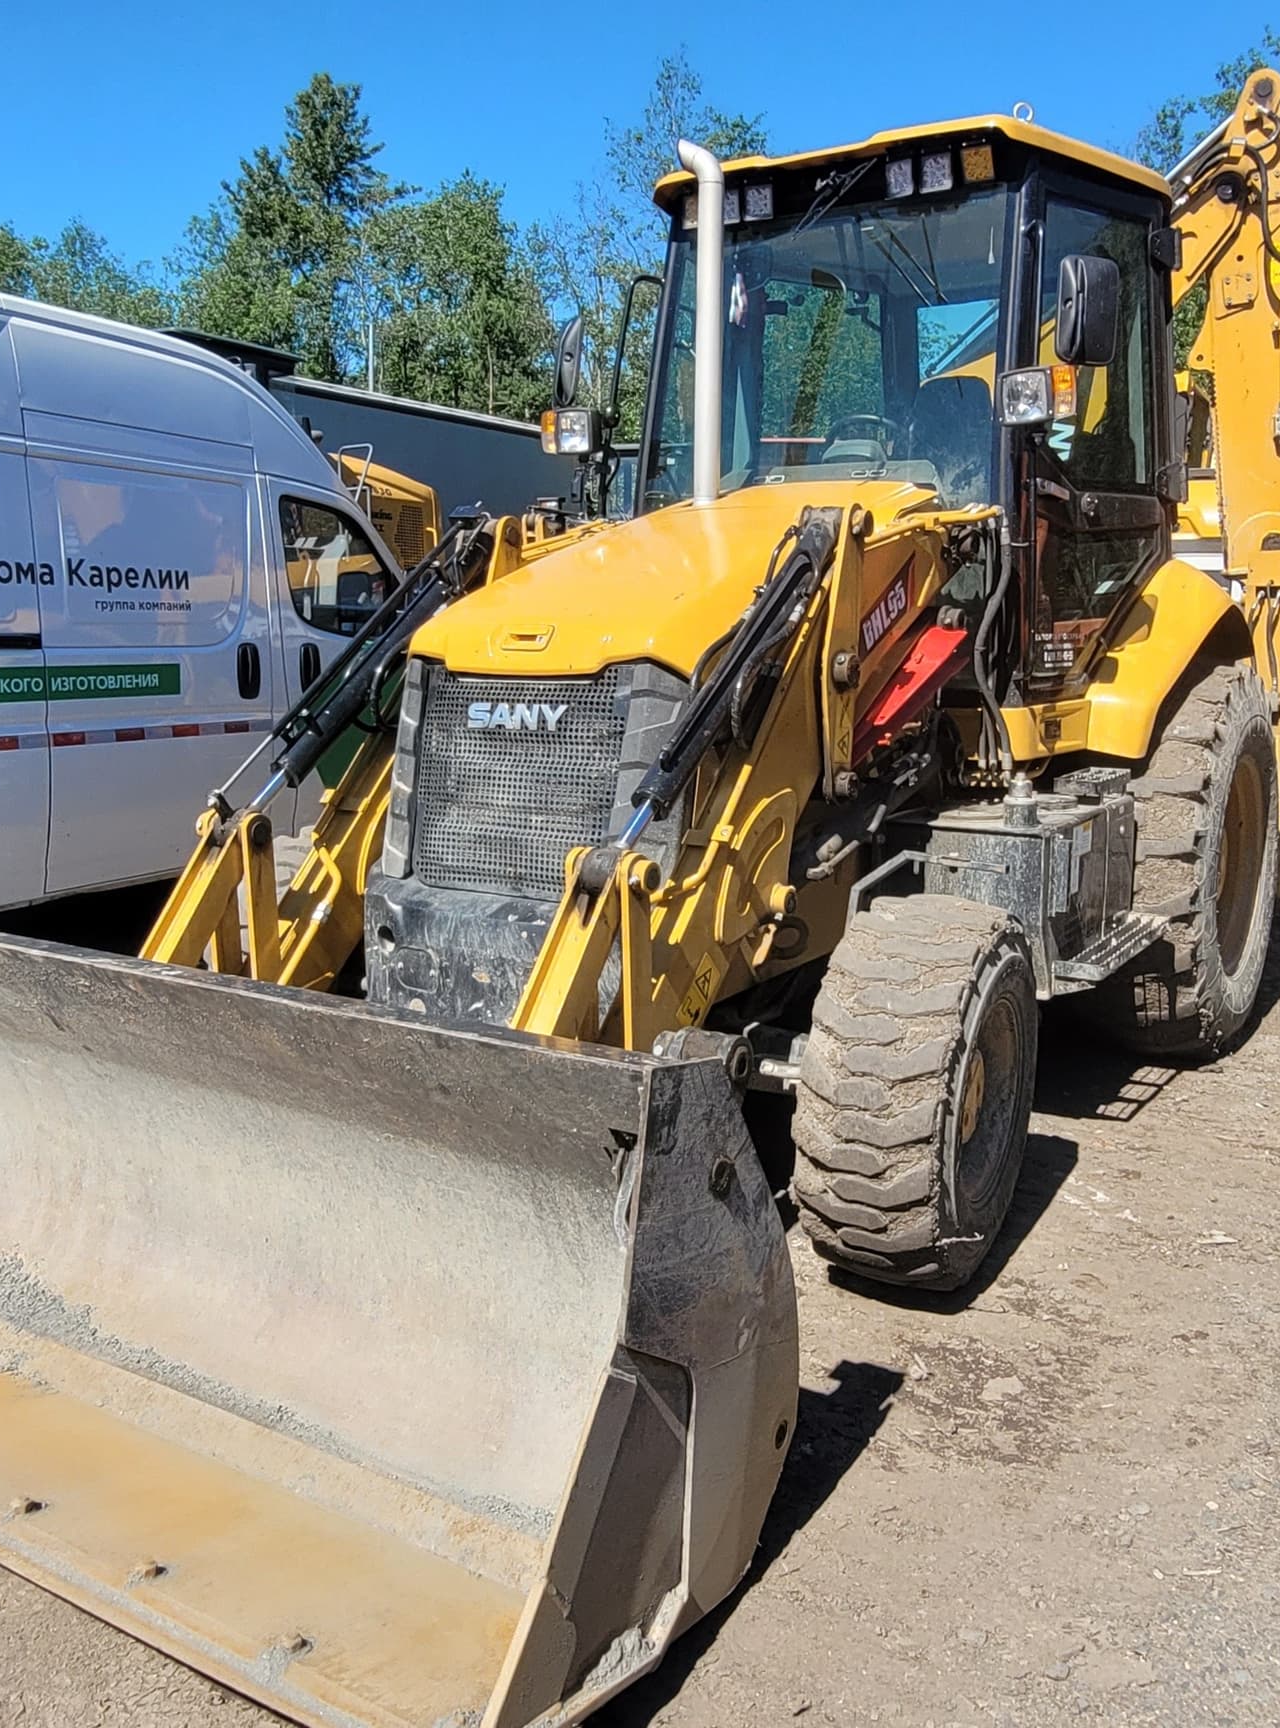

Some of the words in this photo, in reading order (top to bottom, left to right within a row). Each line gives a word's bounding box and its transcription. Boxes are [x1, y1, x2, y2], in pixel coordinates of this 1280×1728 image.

[66, 558, 191, 593] Карелии
[94, 599, 136, 612] группа
[138, 599, 192, 612] компаний
[51, 672, 160, 693] ИЗГОТОВЛЕНИЯ
[467, 702, 568, 732] SANY
